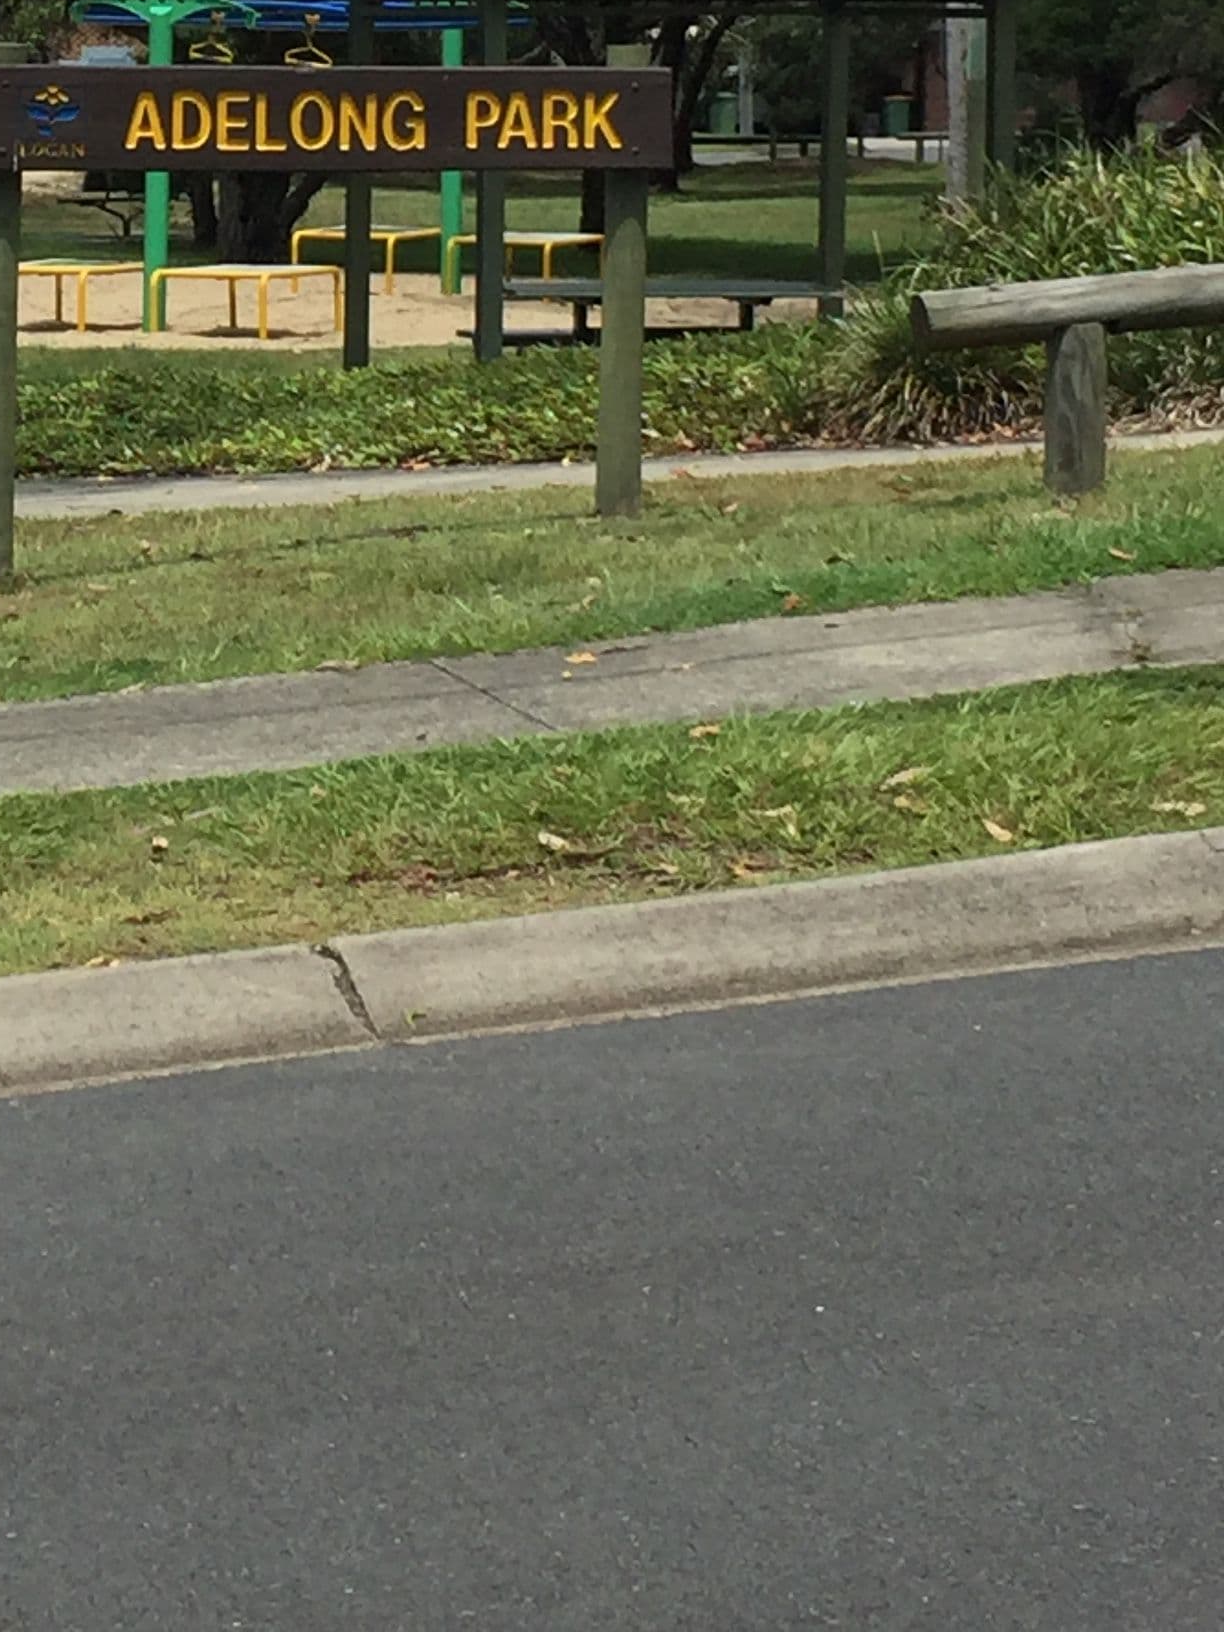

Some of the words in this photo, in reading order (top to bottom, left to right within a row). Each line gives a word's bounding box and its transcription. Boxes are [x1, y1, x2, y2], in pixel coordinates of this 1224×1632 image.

[125, 89, 426, 151] ADELONG
[465, 89, 623, 150] PARK
[19, 142, 86, 158] LOGAN
